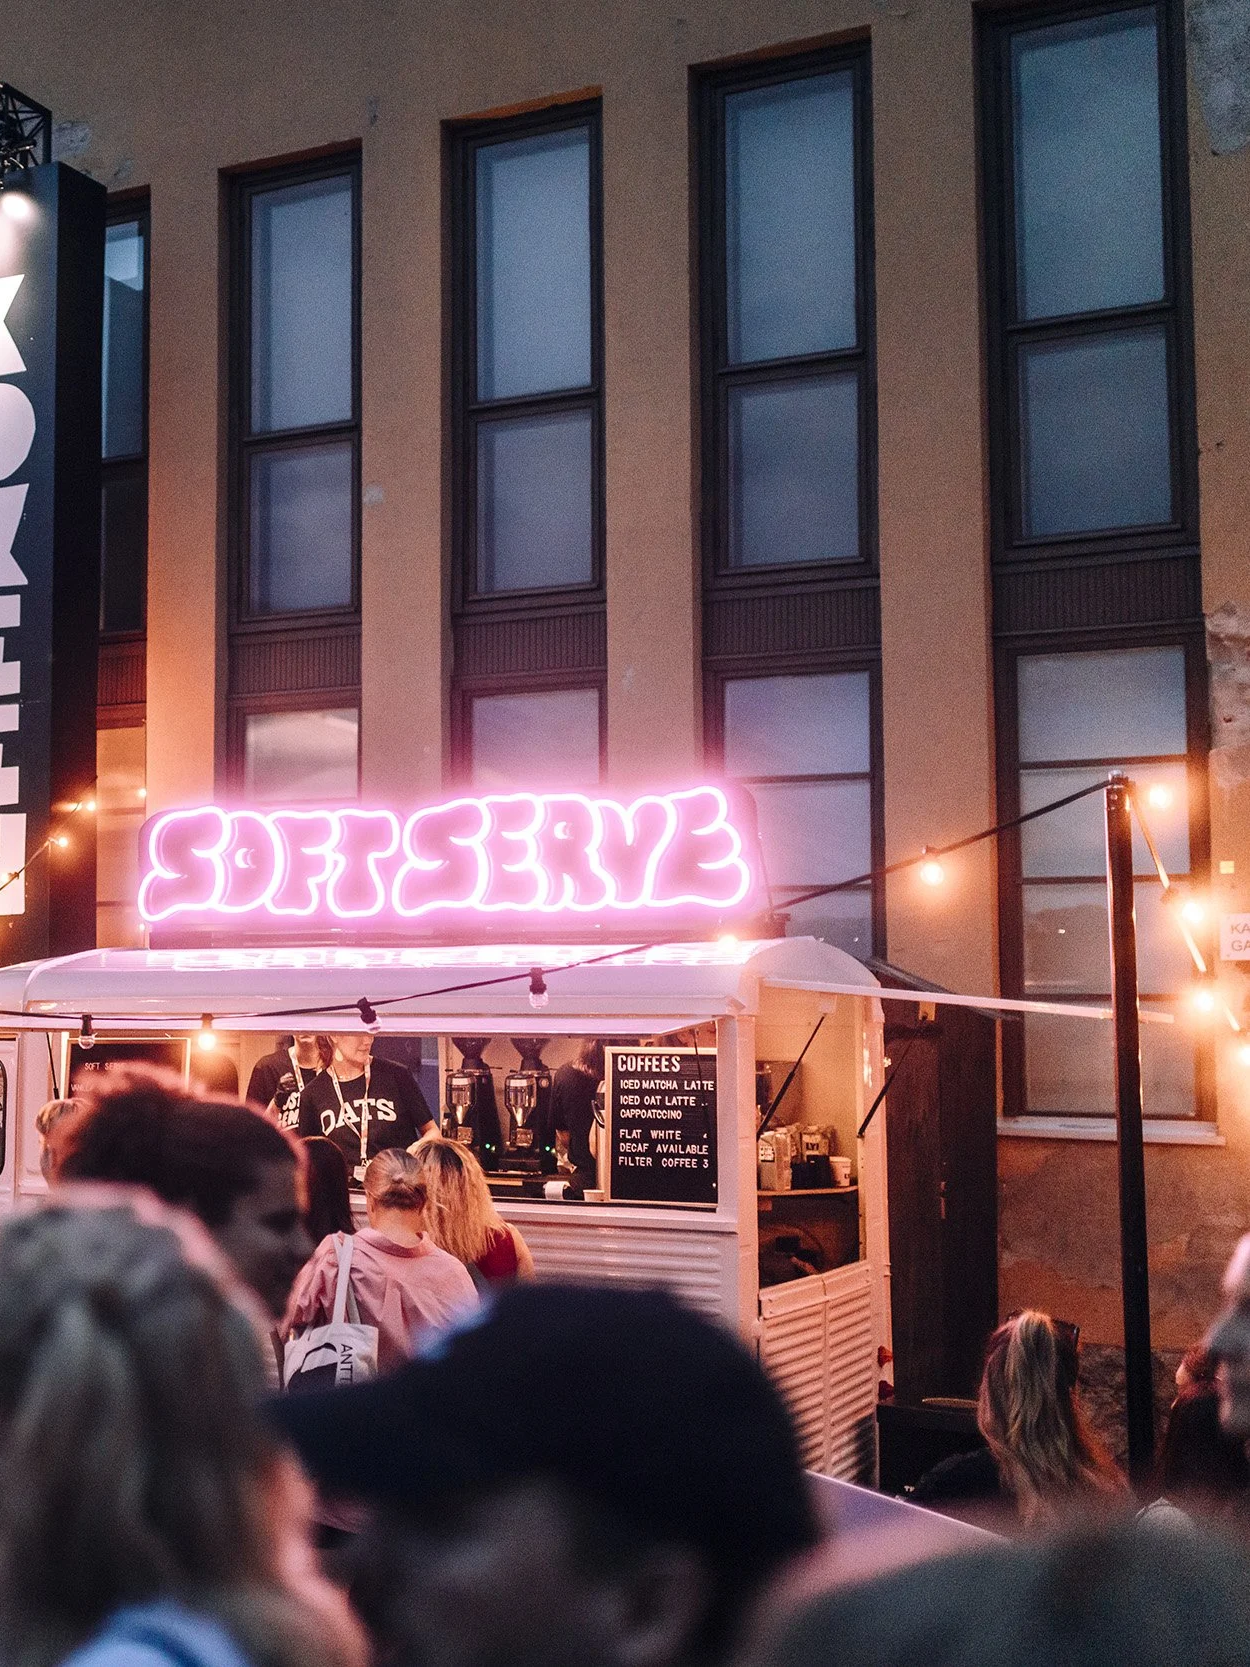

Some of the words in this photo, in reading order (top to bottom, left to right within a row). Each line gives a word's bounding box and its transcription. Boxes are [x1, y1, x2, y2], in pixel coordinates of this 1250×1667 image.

[138, 805, 401, 920] SOFT
[392, 785, 750, 917] SERVE
[617, 1055, 681, 1072] COFFEES
[620, 1079, 640, 1089] ICED
[642, 1080, 678, 1090] MATCHA
[684, 1080, 714, 1091] LATTE
[620, 1095, 640, 1105] ICED
[644, 1095, 662, 1105] OAT
[665, 1096, 696, 1106] LATTE
[320, 1098, 397, 1137] OATS
[619, 1129, 642, 1139] FLAT
[650, 1129, 682, 1140] WHITE
[619, 1143, 649, 1153] DECAF
[656, 1144, 709, 1155] AVAILABLE
[618, 1156, 652, 1167] FILTER
[661, 1157, 698, 1168] COFFEE
[702, 1159, 709, 1169] 3
